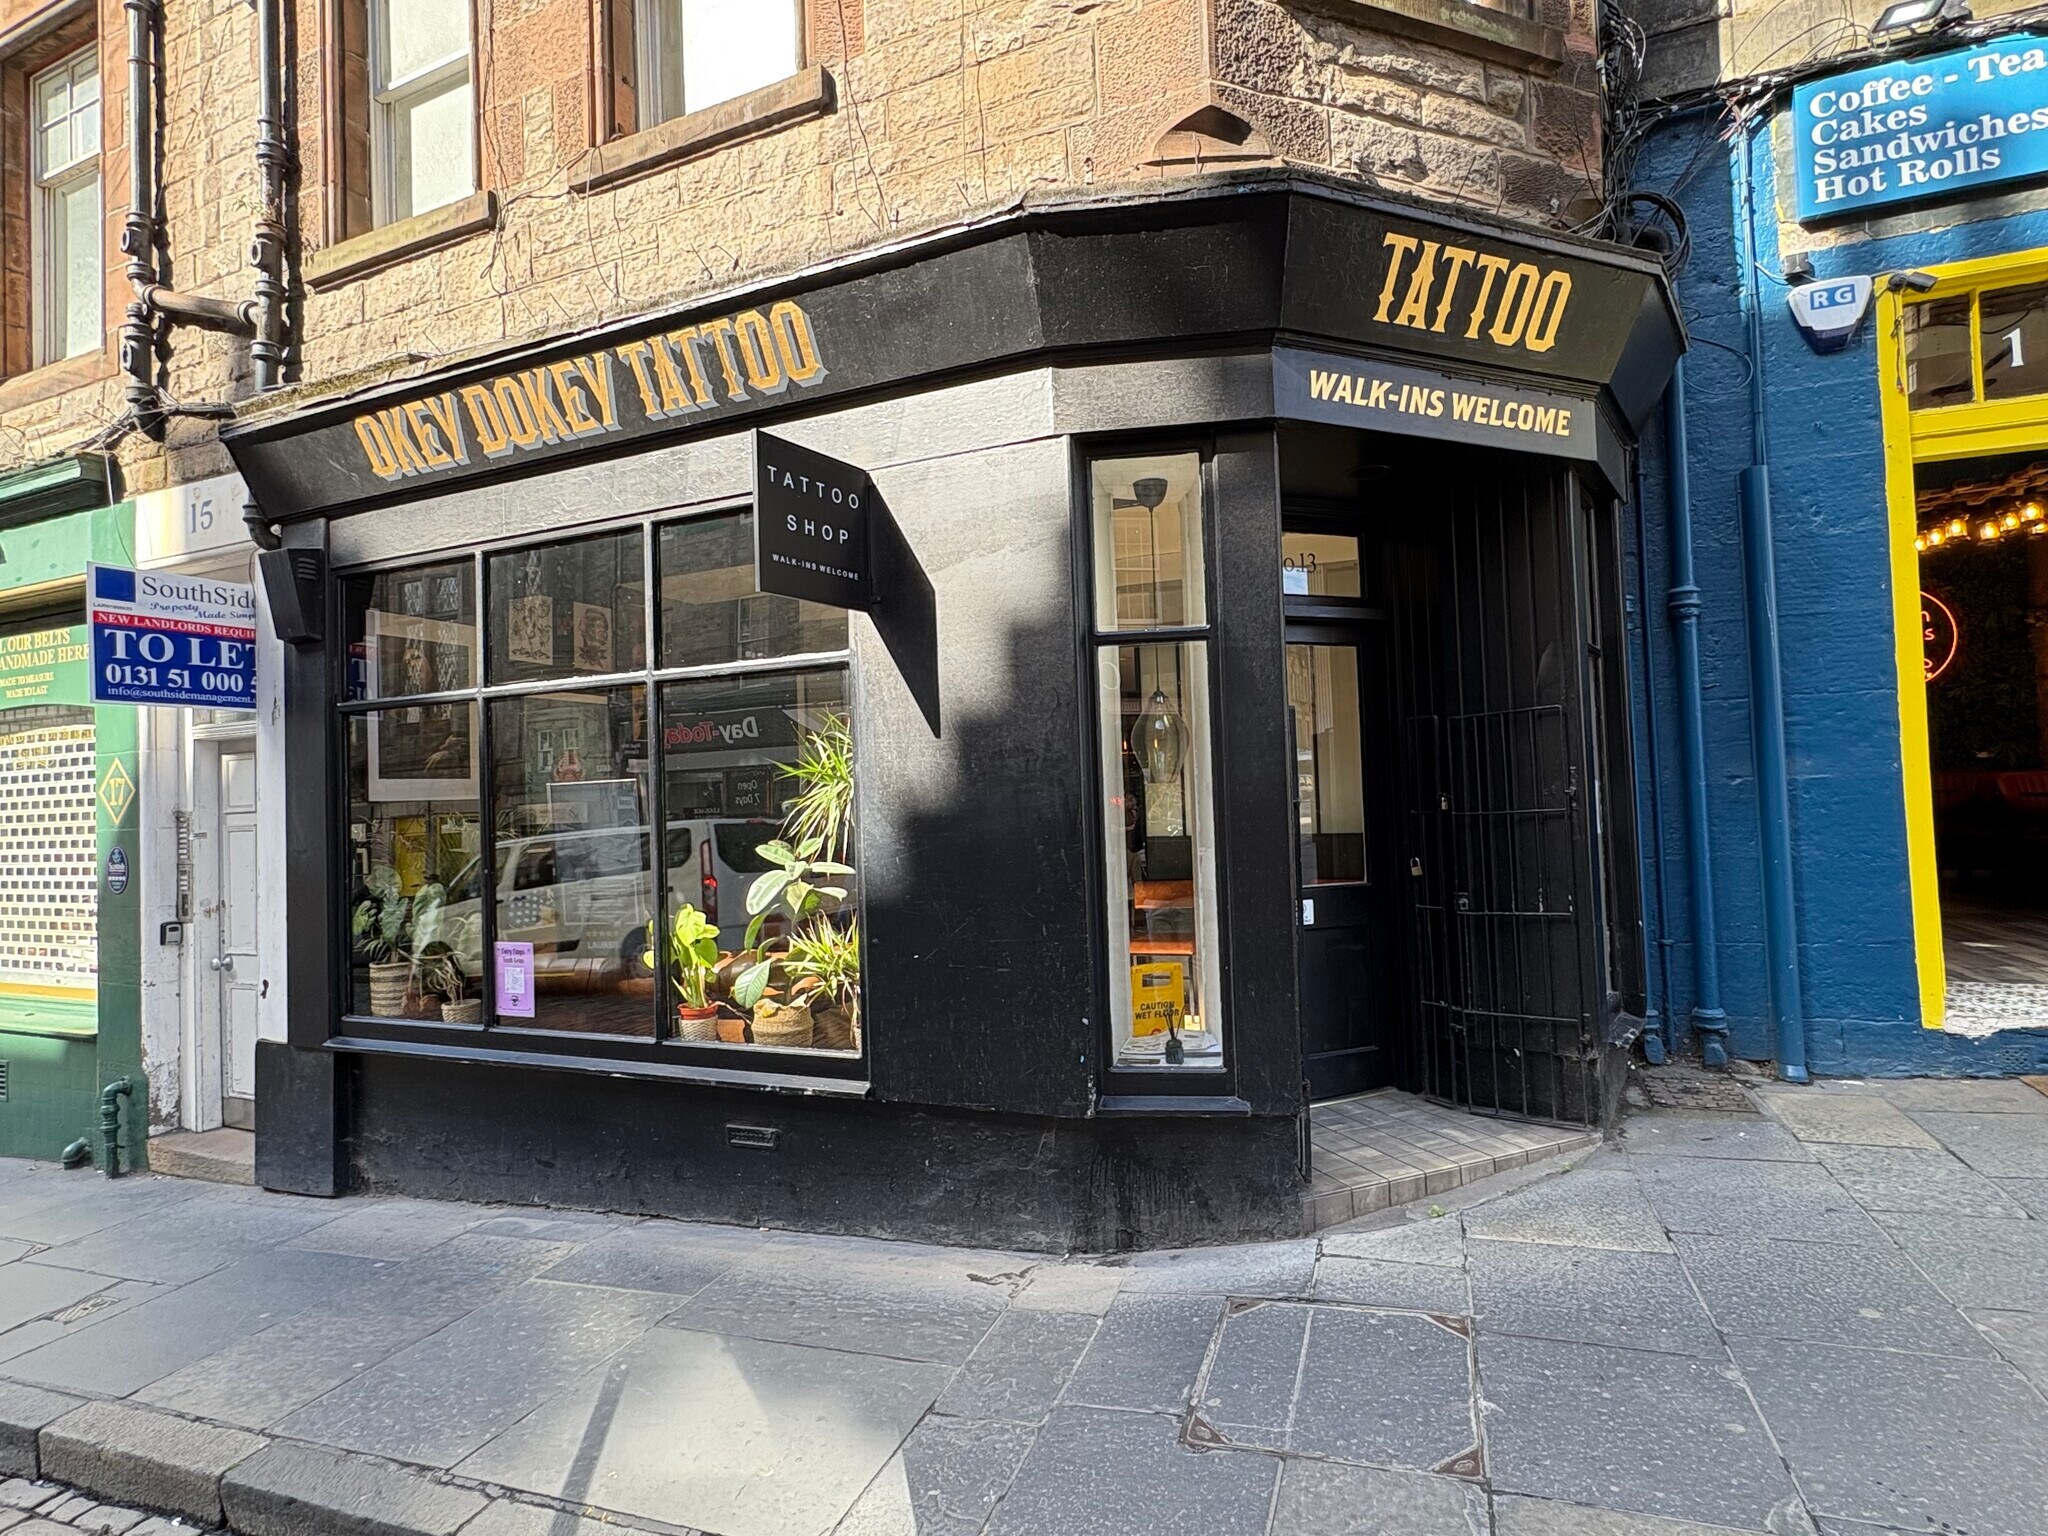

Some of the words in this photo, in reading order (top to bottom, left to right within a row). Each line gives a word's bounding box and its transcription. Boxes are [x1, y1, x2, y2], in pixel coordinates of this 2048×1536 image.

[1809, 73, 1934, 118] Coffee
[1967, 48, 2047, 83] Tea
[1811, 104, 1928, 146] Cakes
[1813, 107, 2048, 176] Sandwiches
[1813, 166, 1887, 204] Hot
[1897, 148, 2002, 187] Rolls
[1372, 232, 1572, 352] TATTOO
[2002, 328, 2025, 367] 1
[354, 394, 470, 481] OKEY
[459, 351, 621, 458] DOKEY
[616, 300, 828, 421] TATTOO
[1309, 370, 1445, 417] WALK-INS
[1452, 393, 1571, 436] WELCOME
[767, 465, 859, 509] TATTOO
[191, 499, 213, 533] 15
[787, 514, 849, 544] SHOP
[772, 553, 816, 570] WALK-INS
[819, 565, 859, 580] WELCOME
[150, 602, 199, 613] Property
[195, 611, 226, 619] Made
[98, 613, 130, 624] NEW
[134, 614, 212, 634] LANDLORDS
[7, 634, 33, 652] OUR
[34, 628, 71, 648] BELTS
[57, 644, 89, 663] HERE
[104, 629, 174, 663] TO
[33, 685, 48, 695] LAST
[106, 664, 160, 687] 0131
[167, 669, 192, 688] 51
[202, 671, 244, 692] 000
[108, 777, 126, 806] 17
[1135, 1011, 1152, 1020] WET
[1140, 1001, 1175, 1011] CAUTION
